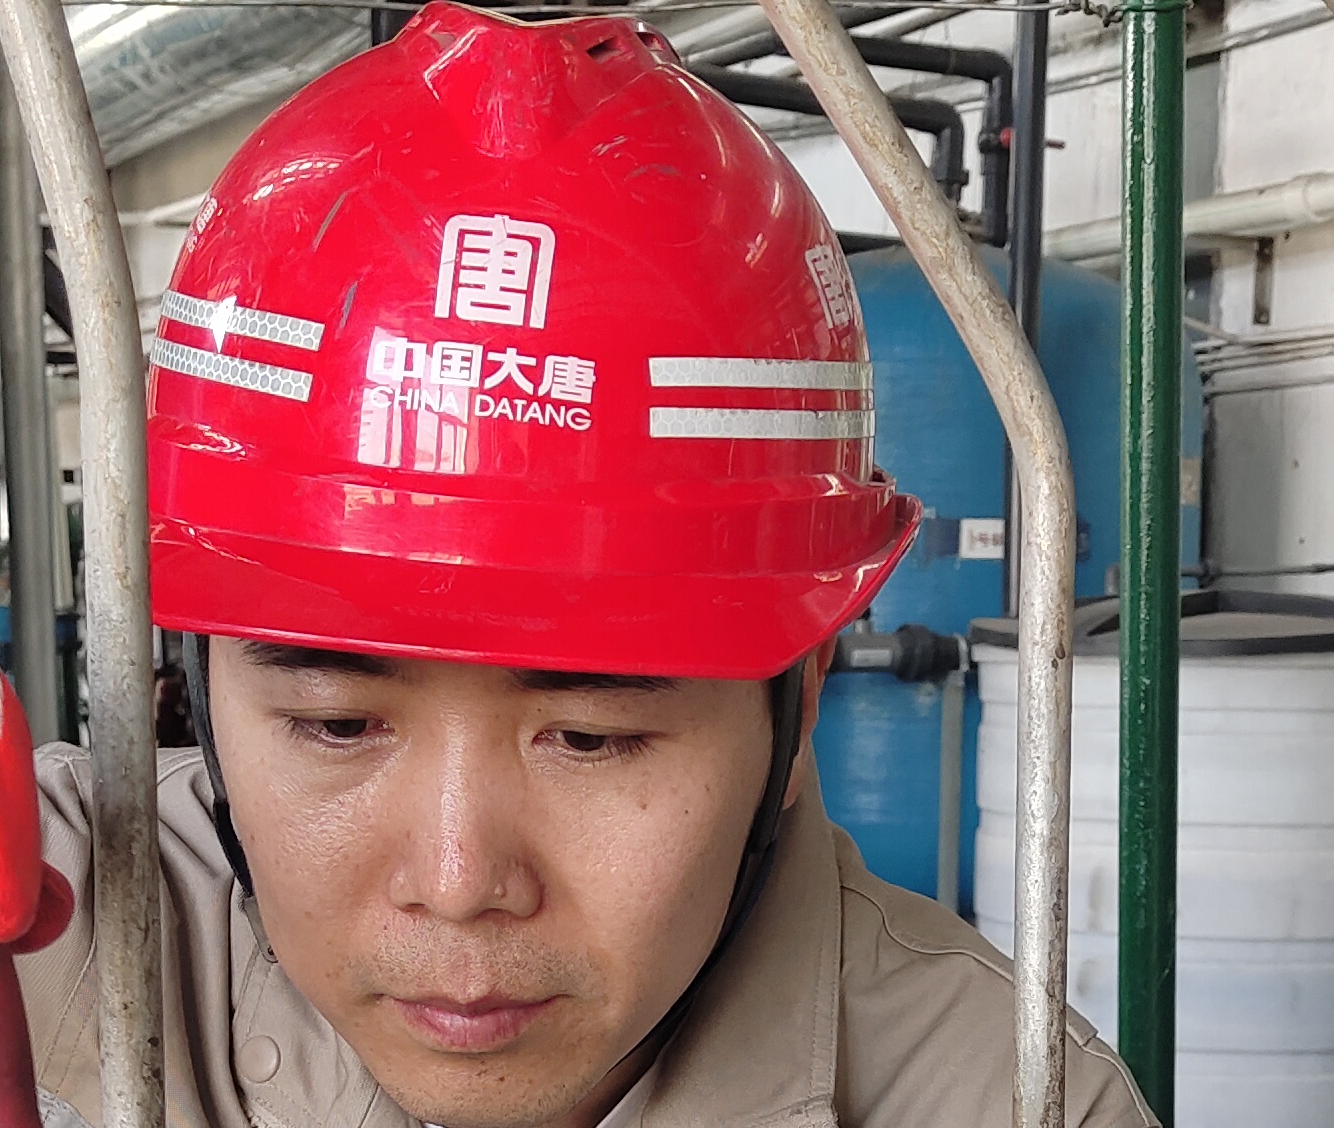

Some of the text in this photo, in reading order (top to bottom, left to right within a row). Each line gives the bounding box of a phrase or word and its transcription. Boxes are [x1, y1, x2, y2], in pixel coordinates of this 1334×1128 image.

[371, 336, 597, 405] 中国大唐
[369, 385, 593, 432] CHINA DATANG
